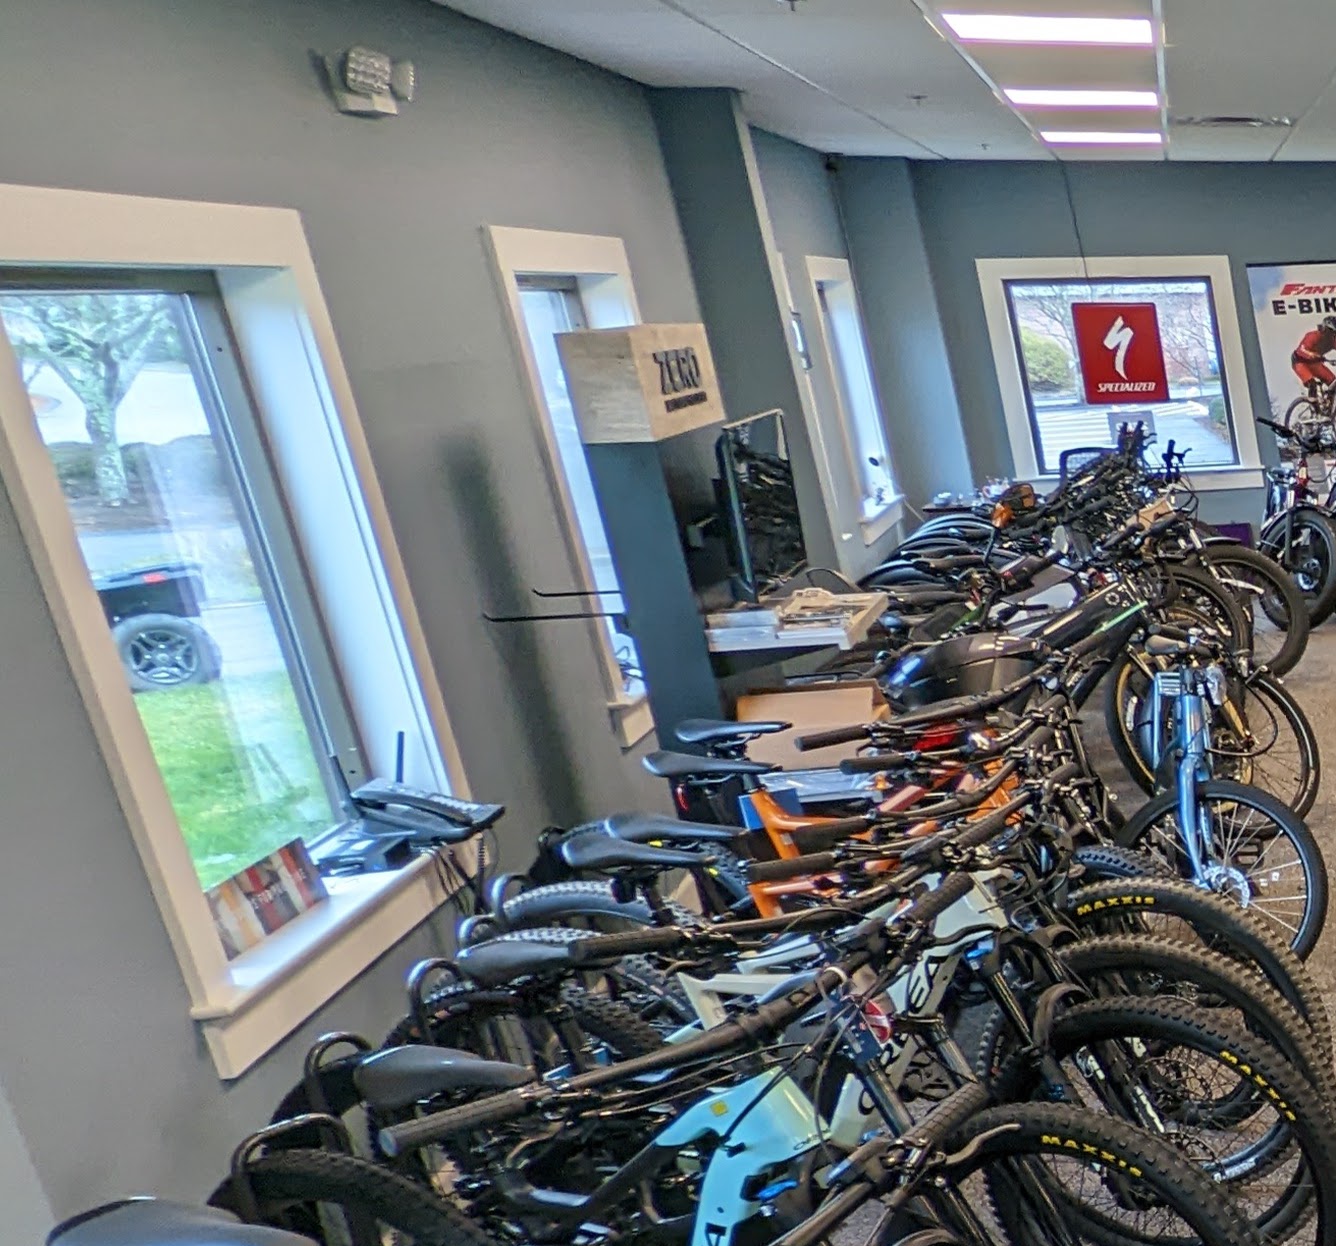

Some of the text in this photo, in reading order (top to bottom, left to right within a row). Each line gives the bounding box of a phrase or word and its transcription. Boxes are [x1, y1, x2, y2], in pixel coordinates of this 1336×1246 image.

[1097, 382, 1156, 393] SPECIALIZED
[1077, 896, 1155, 916] MAXXIS
[1219, 1050, 1297, 1122] MAXXIS
[1041, 1134, 1143, 1178] MAXXIS
